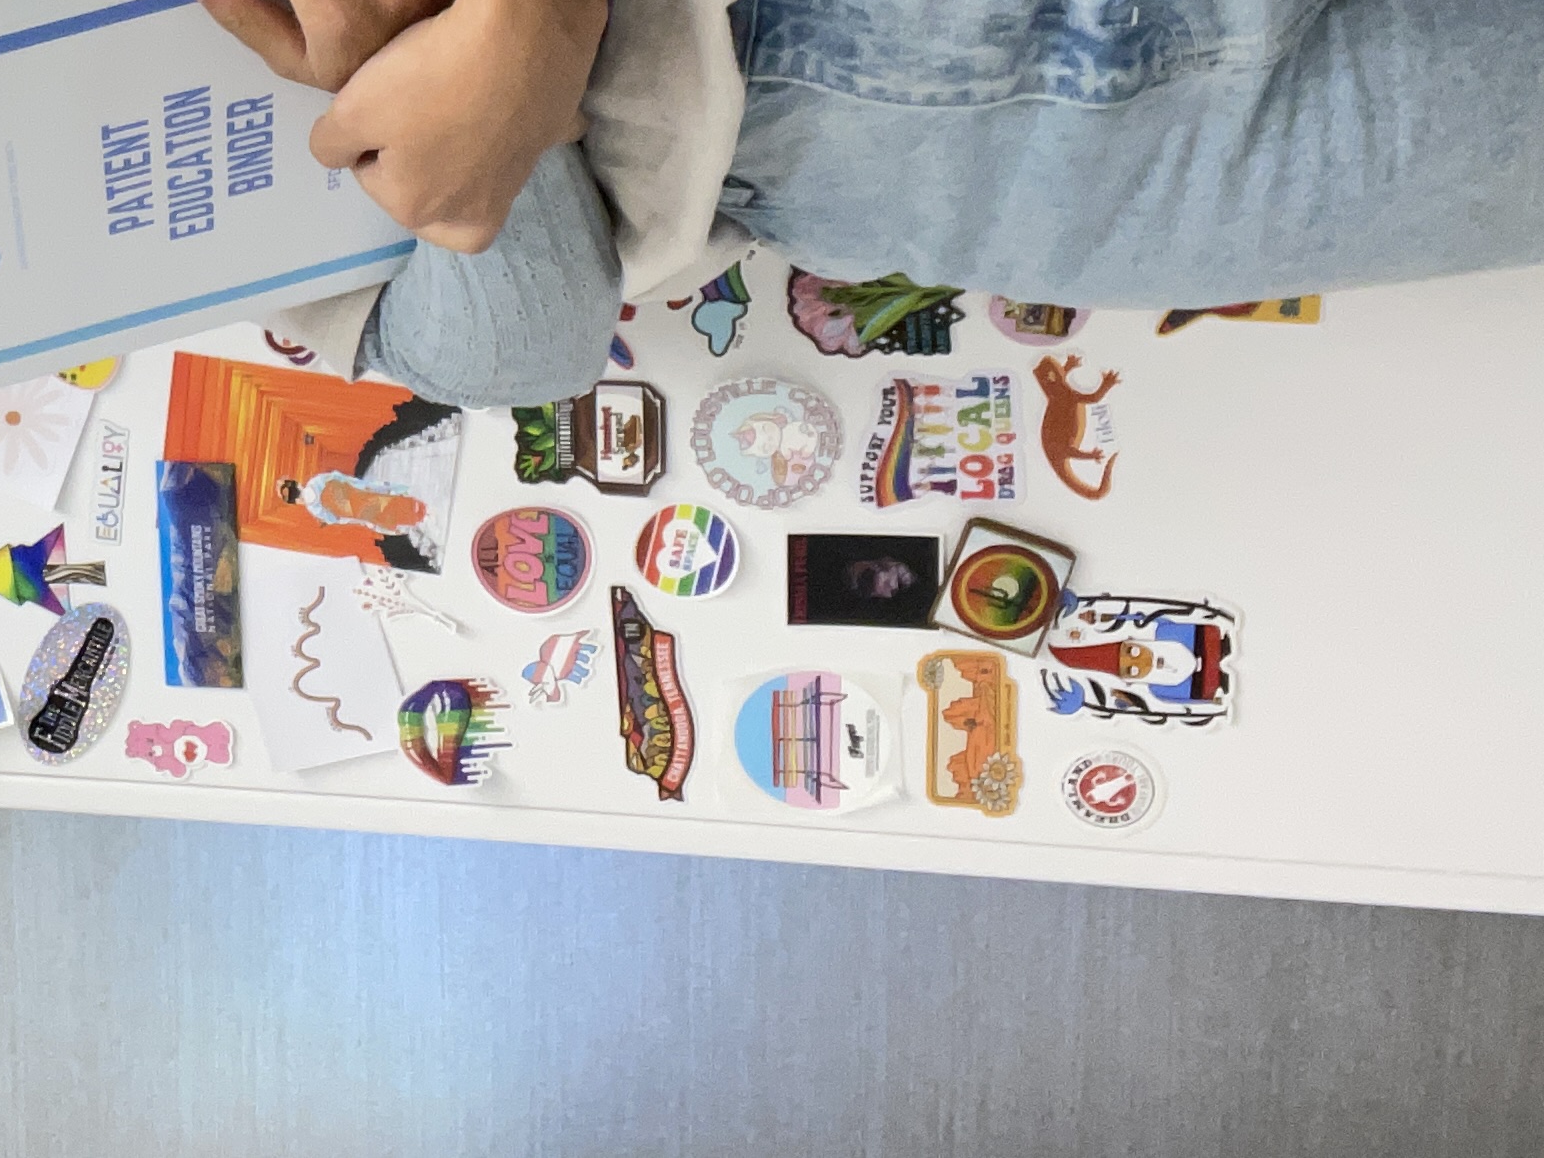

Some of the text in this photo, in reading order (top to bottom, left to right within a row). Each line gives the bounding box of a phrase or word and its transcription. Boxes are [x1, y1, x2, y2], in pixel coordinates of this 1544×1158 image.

[101, 119, 155, 235] PATIENT
[163, 84, 215, 241] EDUCATION
[226, 92, 274, 197] BINDER
[859, 385, 896, 503] SUPPORT YOUR
[955, 376, 995, 501] LOCAL
[992, 375, 1017, 499] DRAG QUEENS
[477, 538, 499, 578] ALL
[503, 511, 550, 606] LOVE
[555, 526, 577, 591] EQUAL
[669, 529, 688, 568] SAFE
[655, 642, 681, 702] TENNESSEE
